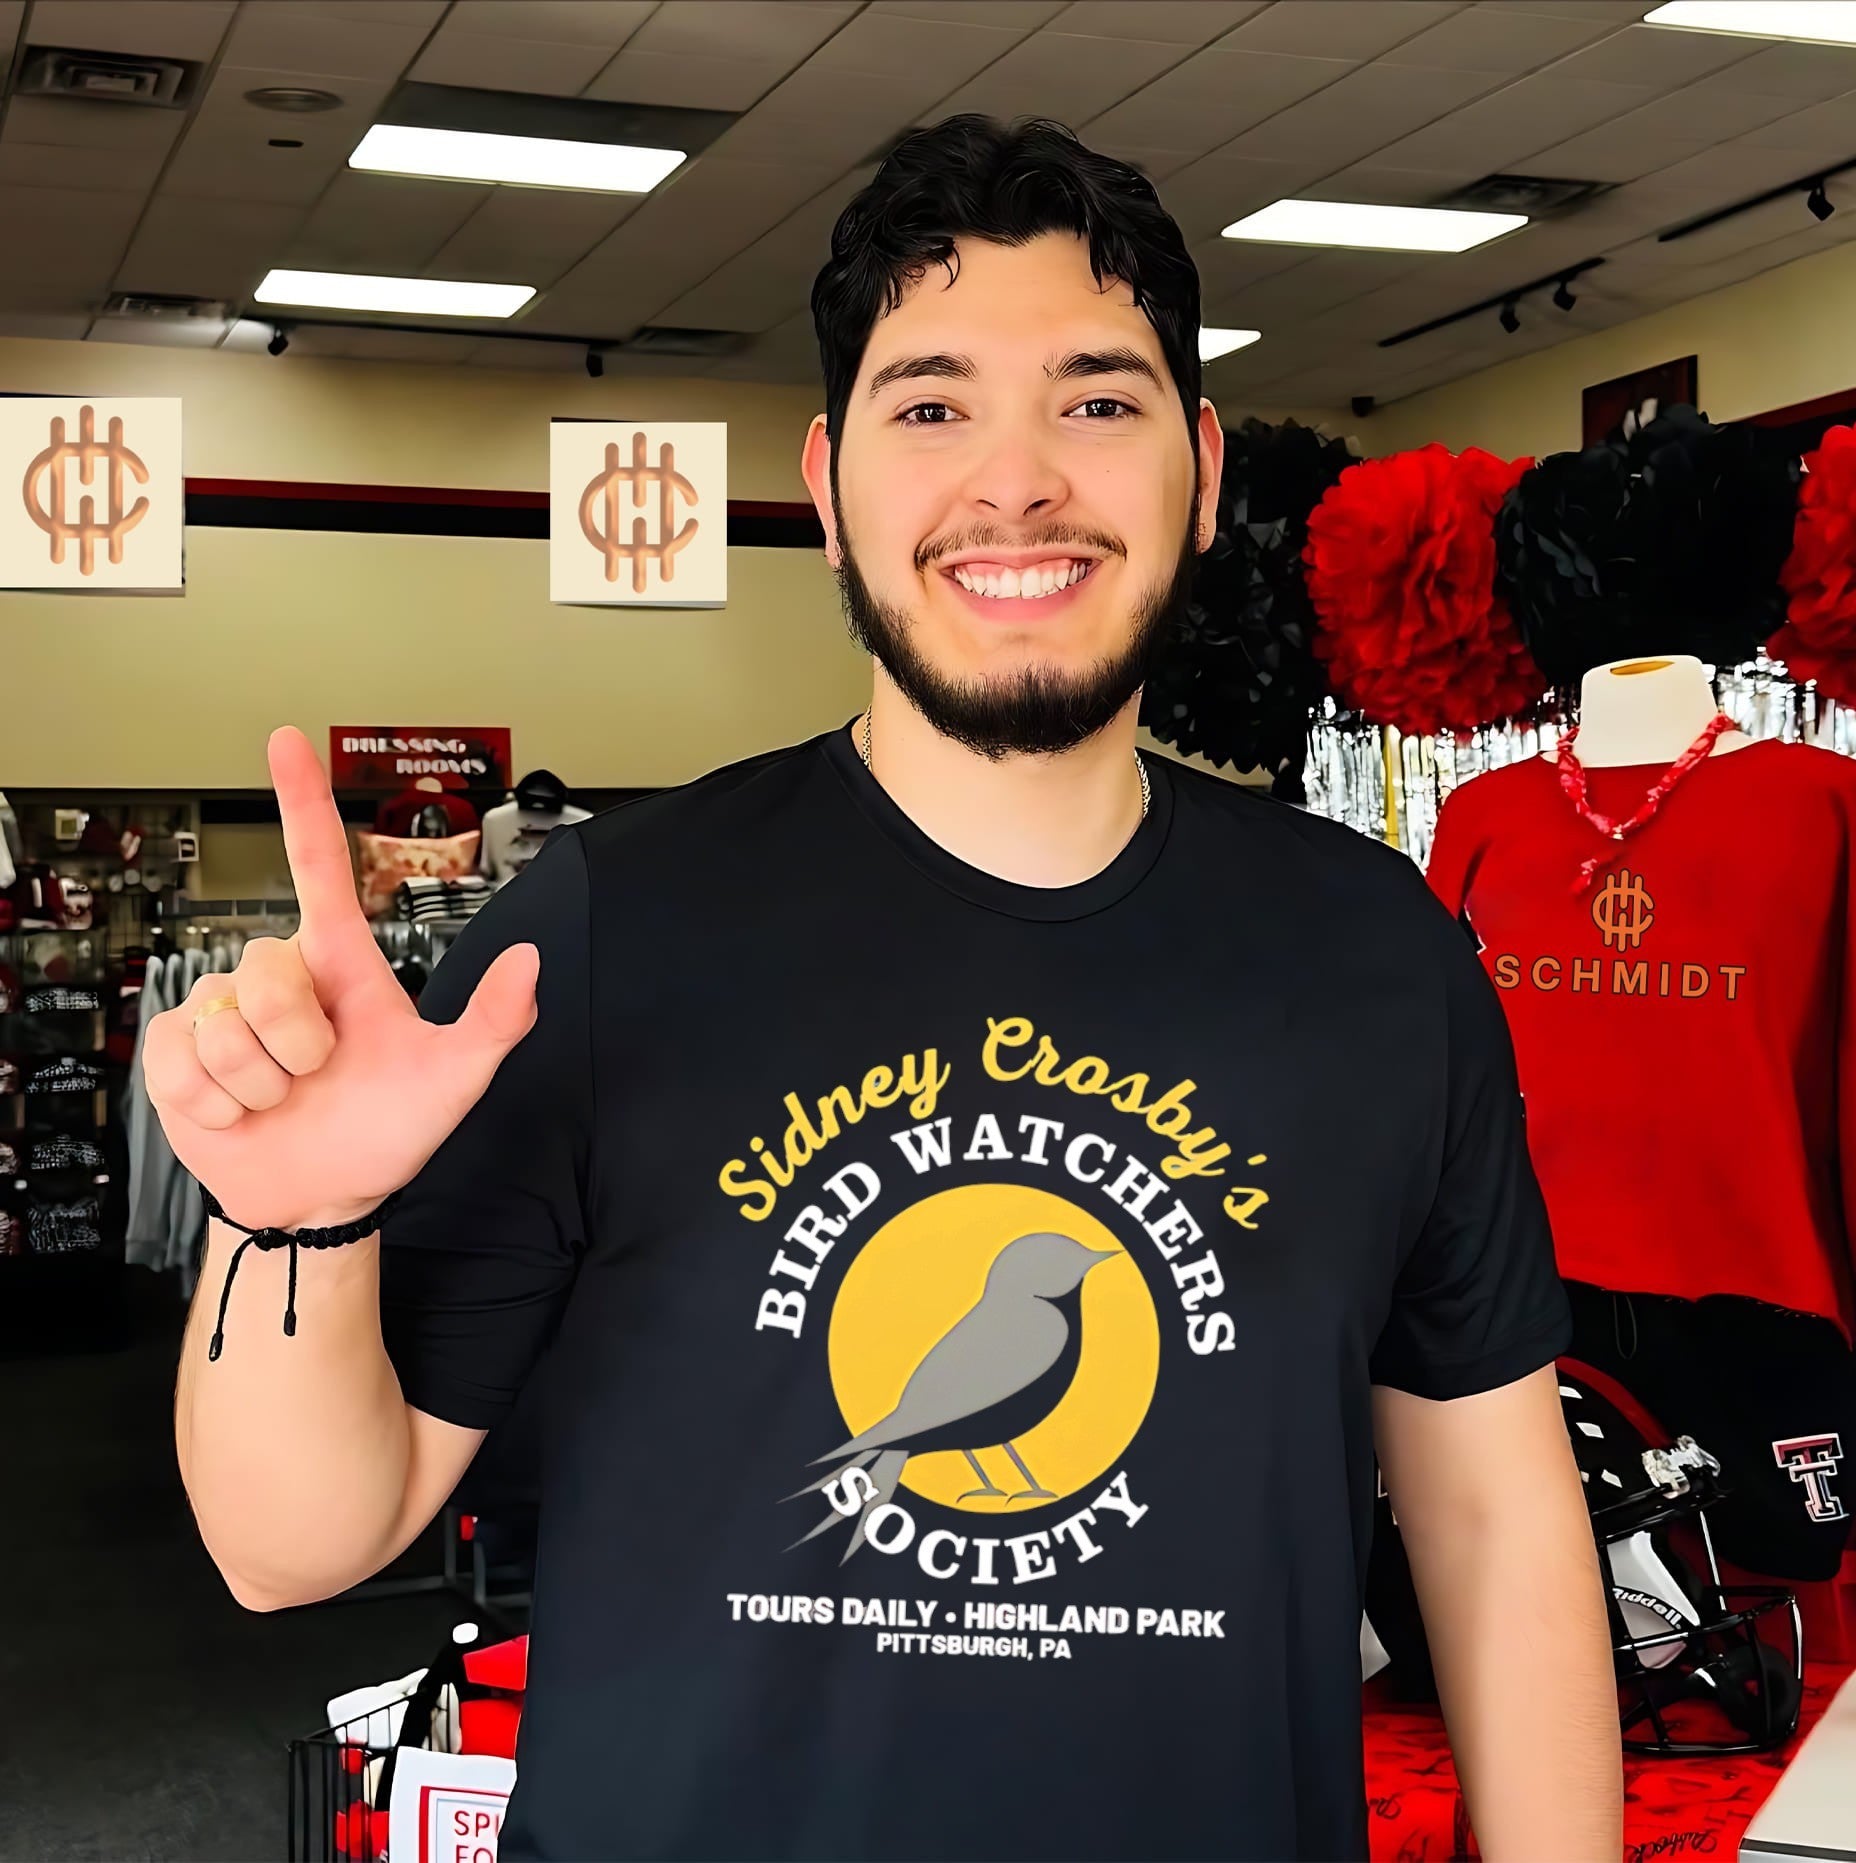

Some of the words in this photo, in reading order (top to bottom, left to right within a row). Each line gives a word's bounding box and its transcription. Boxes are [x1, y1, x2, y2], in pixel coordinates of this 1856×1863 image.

[1494, 955, 1746, 1000] SCHMIDT
[718, 1048, 951, 1222] Sidney
[981, 1017, 1269, 1229] Crosby's
[755, 1162, 881, 1339] BIRD
[890, 1113, 1236, 1355] WATCHERS
[821, 1466, 1149, 1585] SOCIETY
[726, 1593, 834, 1625] TOURS
[842, 1598, 938, 1628] DAILY
[964, 1602, 1129, 1635] HIGHLAND
[1137, 1608, 1225, 1639] PARK
[876, 1632, 1033, 1660] PITTSBURGH,
[1040, 1638, 1072, 1660] PA
